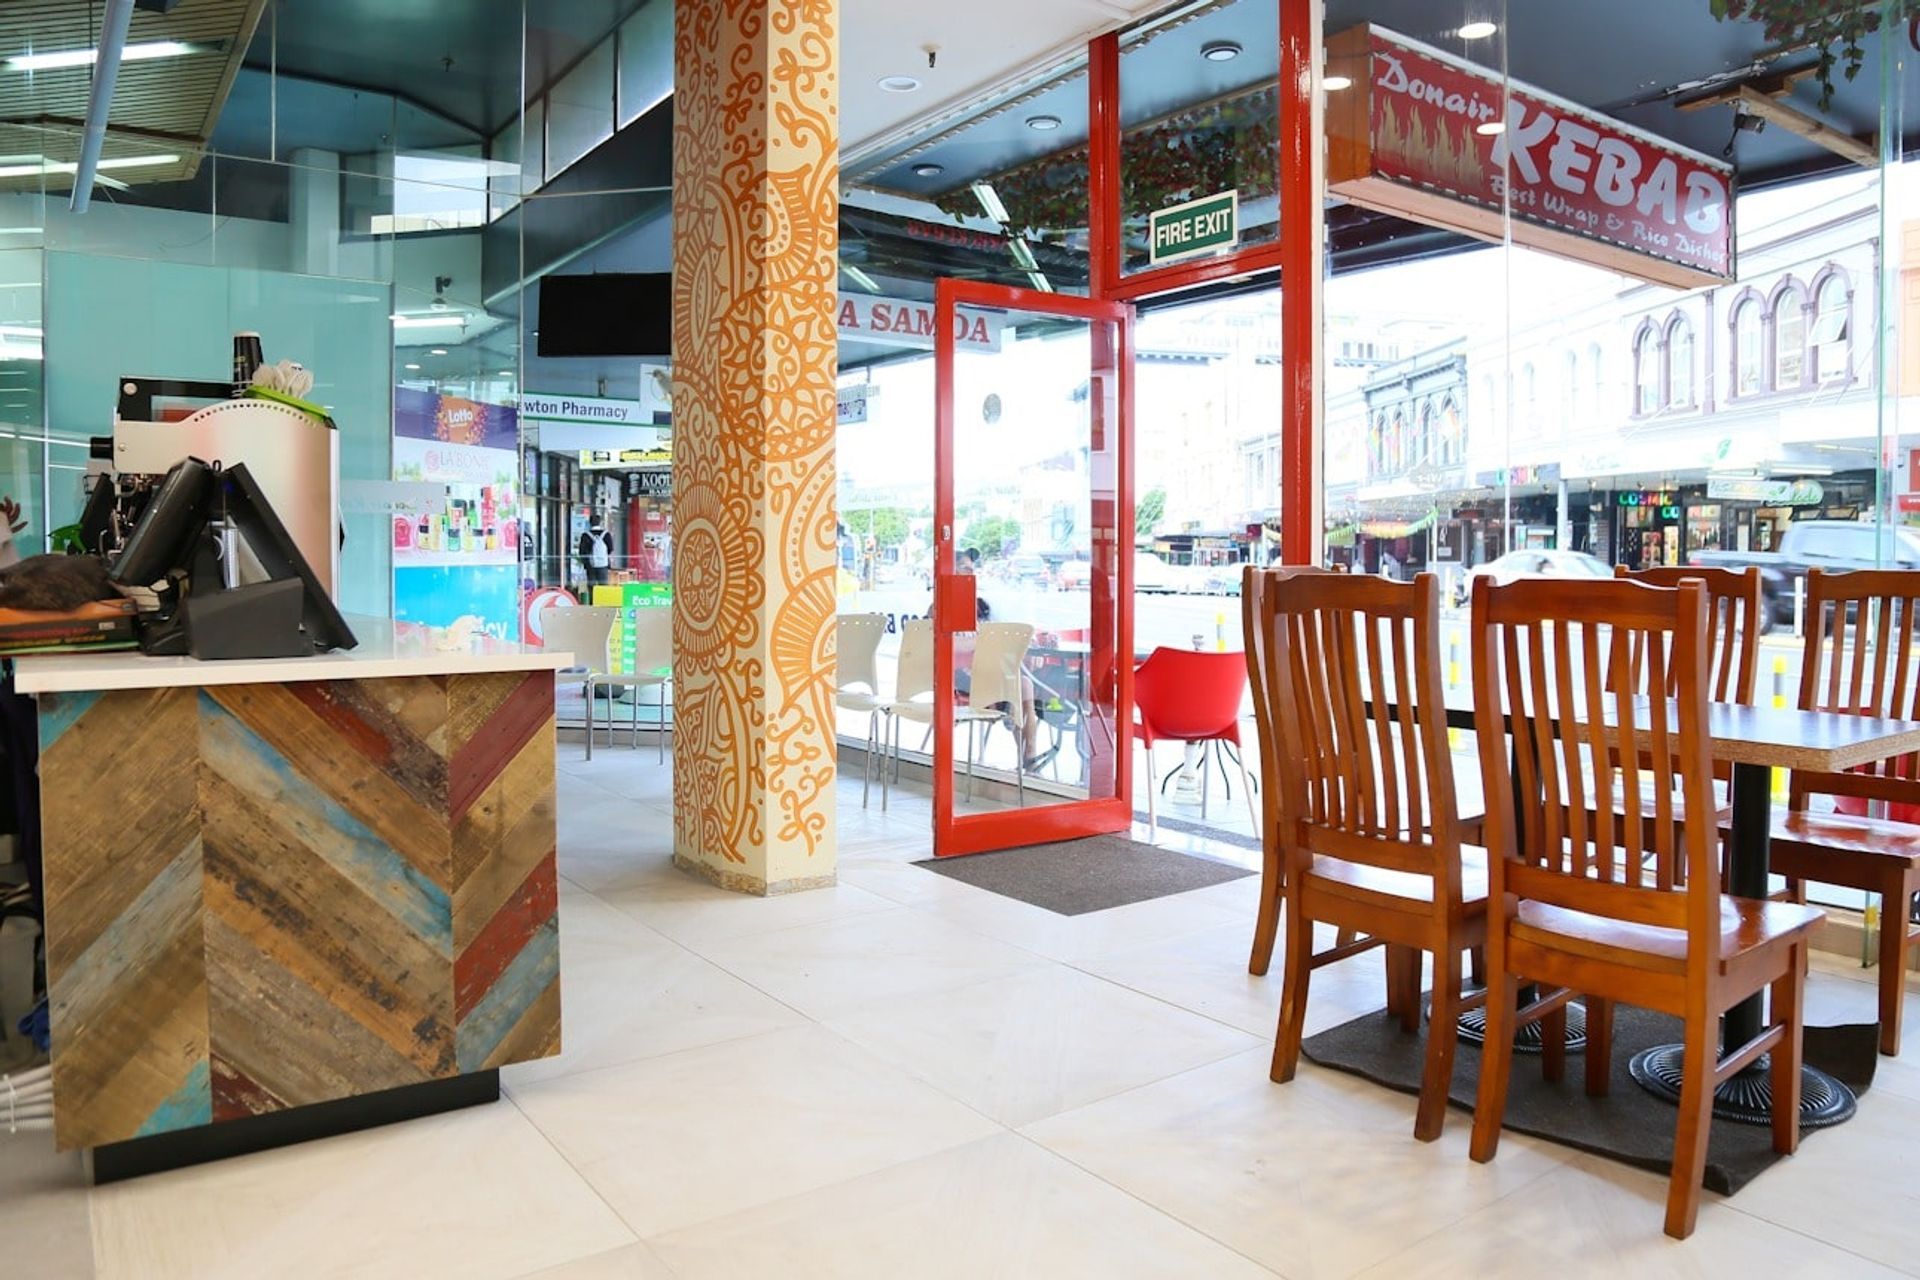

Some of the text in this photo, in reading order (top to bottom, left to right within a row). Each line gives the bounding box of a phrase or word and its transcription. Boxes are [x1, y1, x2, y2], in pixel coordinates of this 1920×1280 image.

[1373, 51, 1495, 121] Donair
[1489, 100, 1725, 234] KEBAB
[1490, 175, 1536, 206] Best
[1543, 191, 1599, 228] Wrap
[1605, 212, 1624, 231] &
[1157, 208, 1231, 248] FIRE EXIT
[870, 303, 990, 343] SAMOA
[447, 408, 473, 423] Lotto
[520, 401, 628, 421] wton Pharmacy
[1619, 490, 1673, 506] COSMIC
[632, 595, 650, 606] Eco
